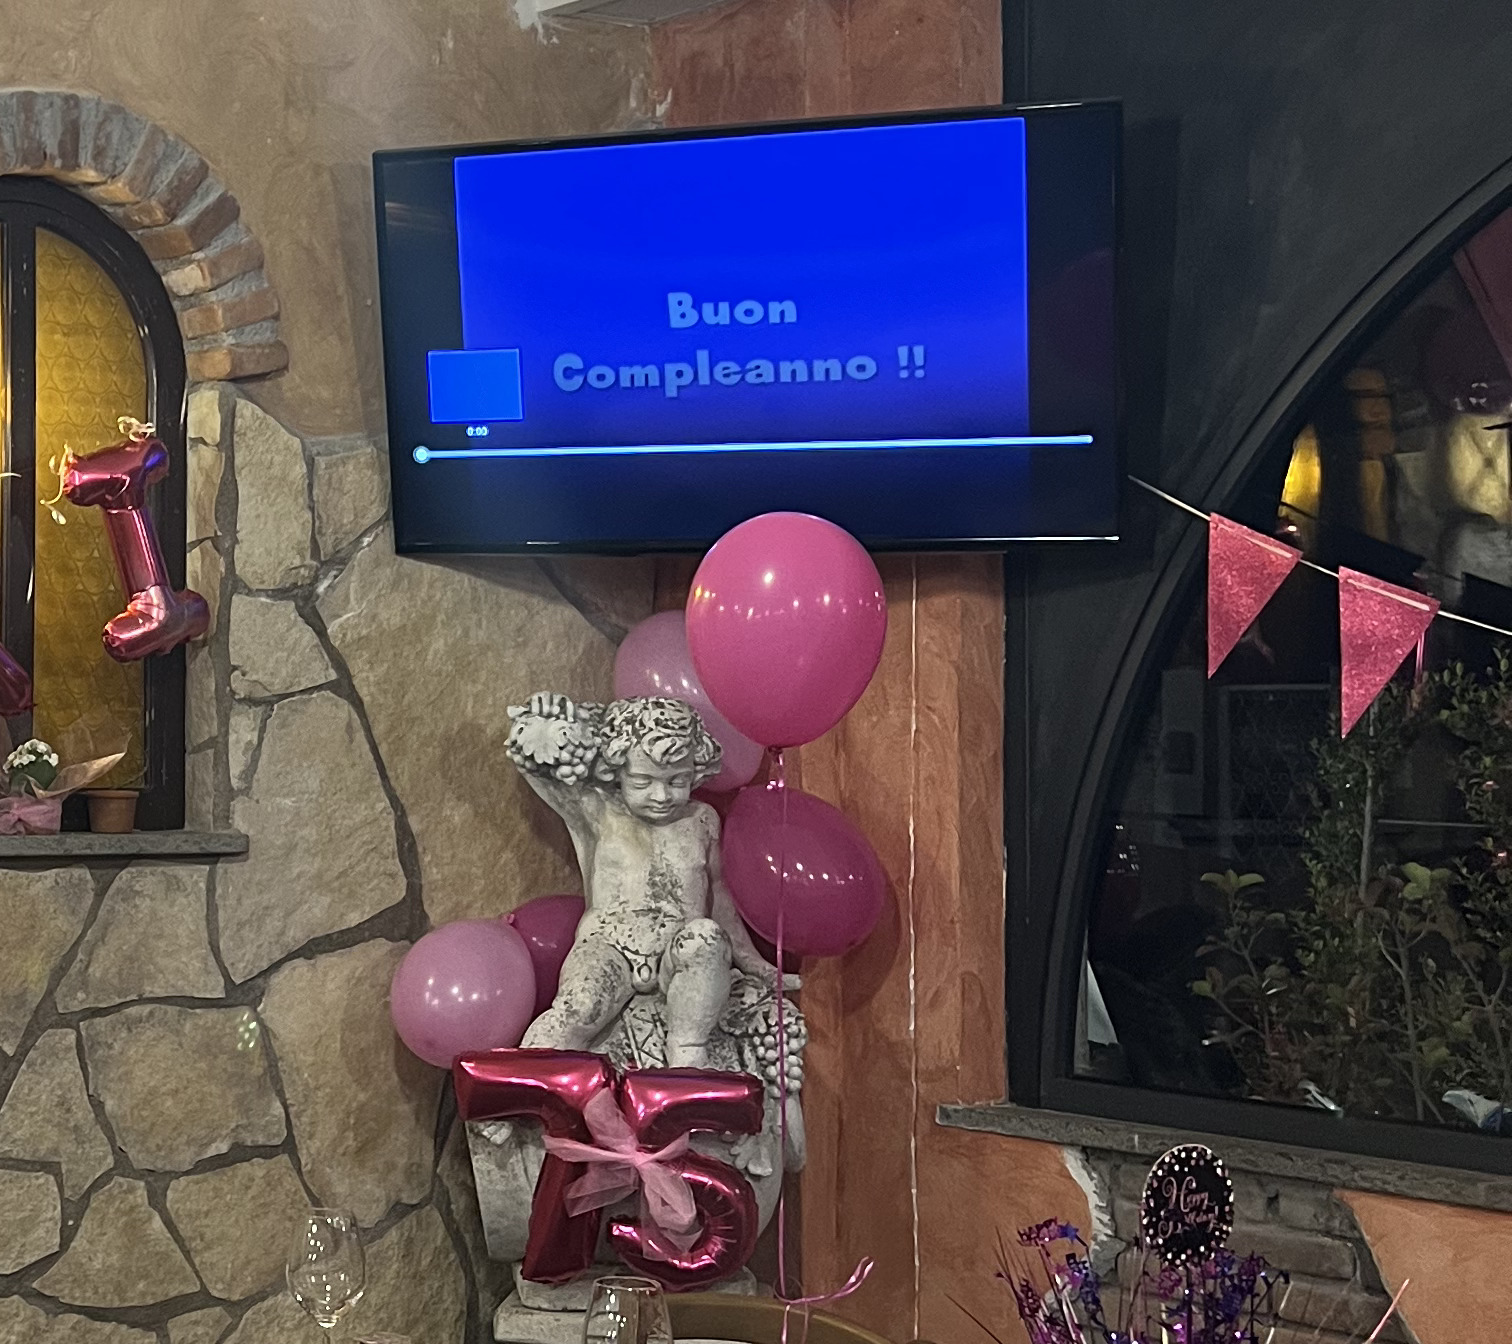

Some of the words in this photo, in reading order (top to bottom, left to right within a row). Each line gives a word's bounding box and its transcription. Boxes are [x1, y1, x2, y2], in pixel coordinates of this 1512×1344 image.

[667, 291, 797, 329] Buon
[553, 349, 877, 398] Compleanno
[897, 345, 925, 379] !!
[453, 1047, 765, 1291] 75
